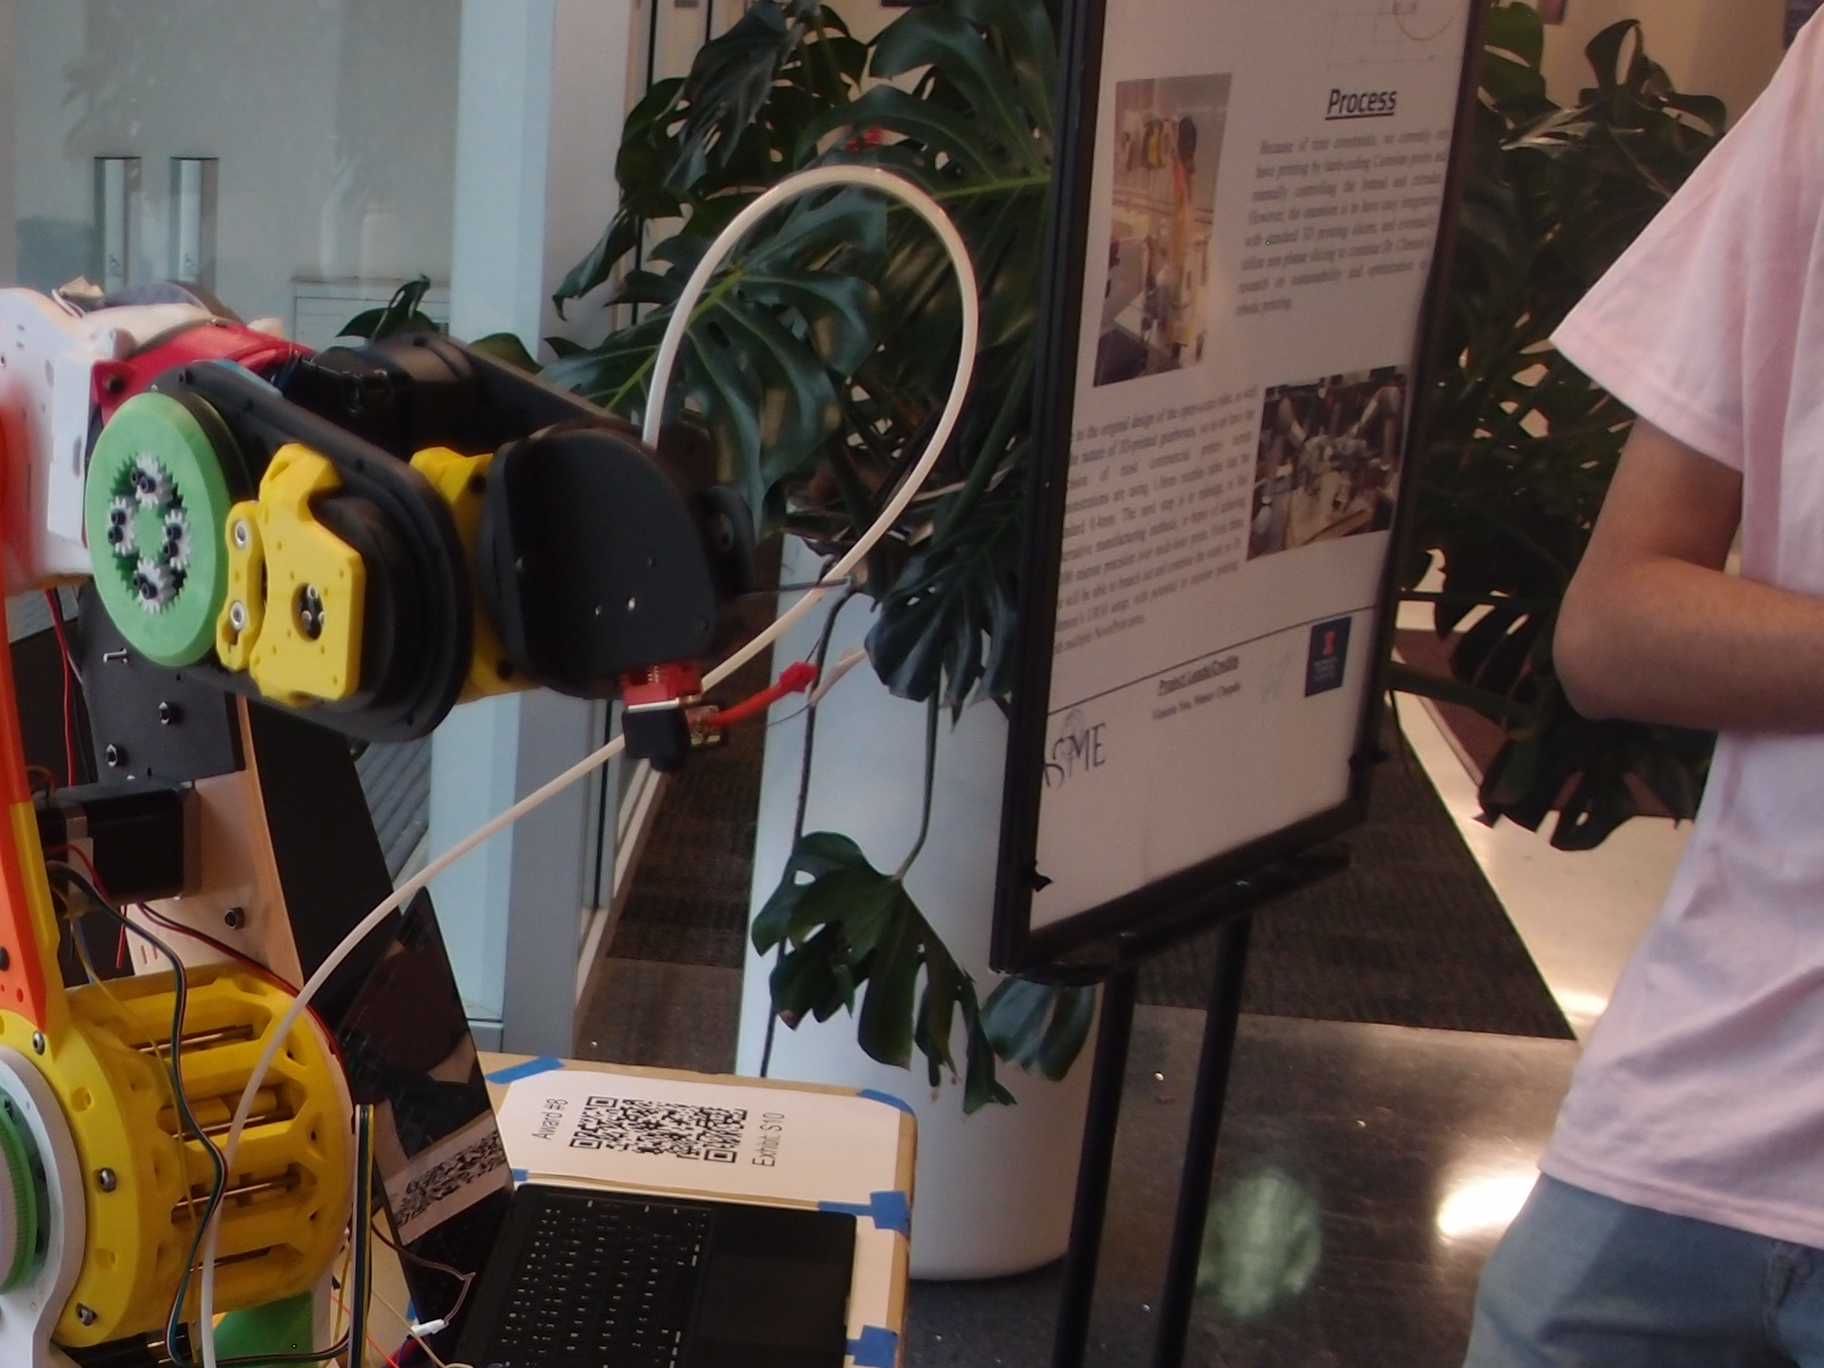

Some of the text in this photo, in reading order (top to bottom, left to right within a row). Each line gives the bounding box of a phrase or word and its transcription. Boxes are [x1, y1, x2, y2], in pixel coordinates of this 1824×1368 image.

[1326, 88, 1397, 115] Process
[531, 1111, 563, 1141] Award
[760, 1112, 785, 1131] S10
